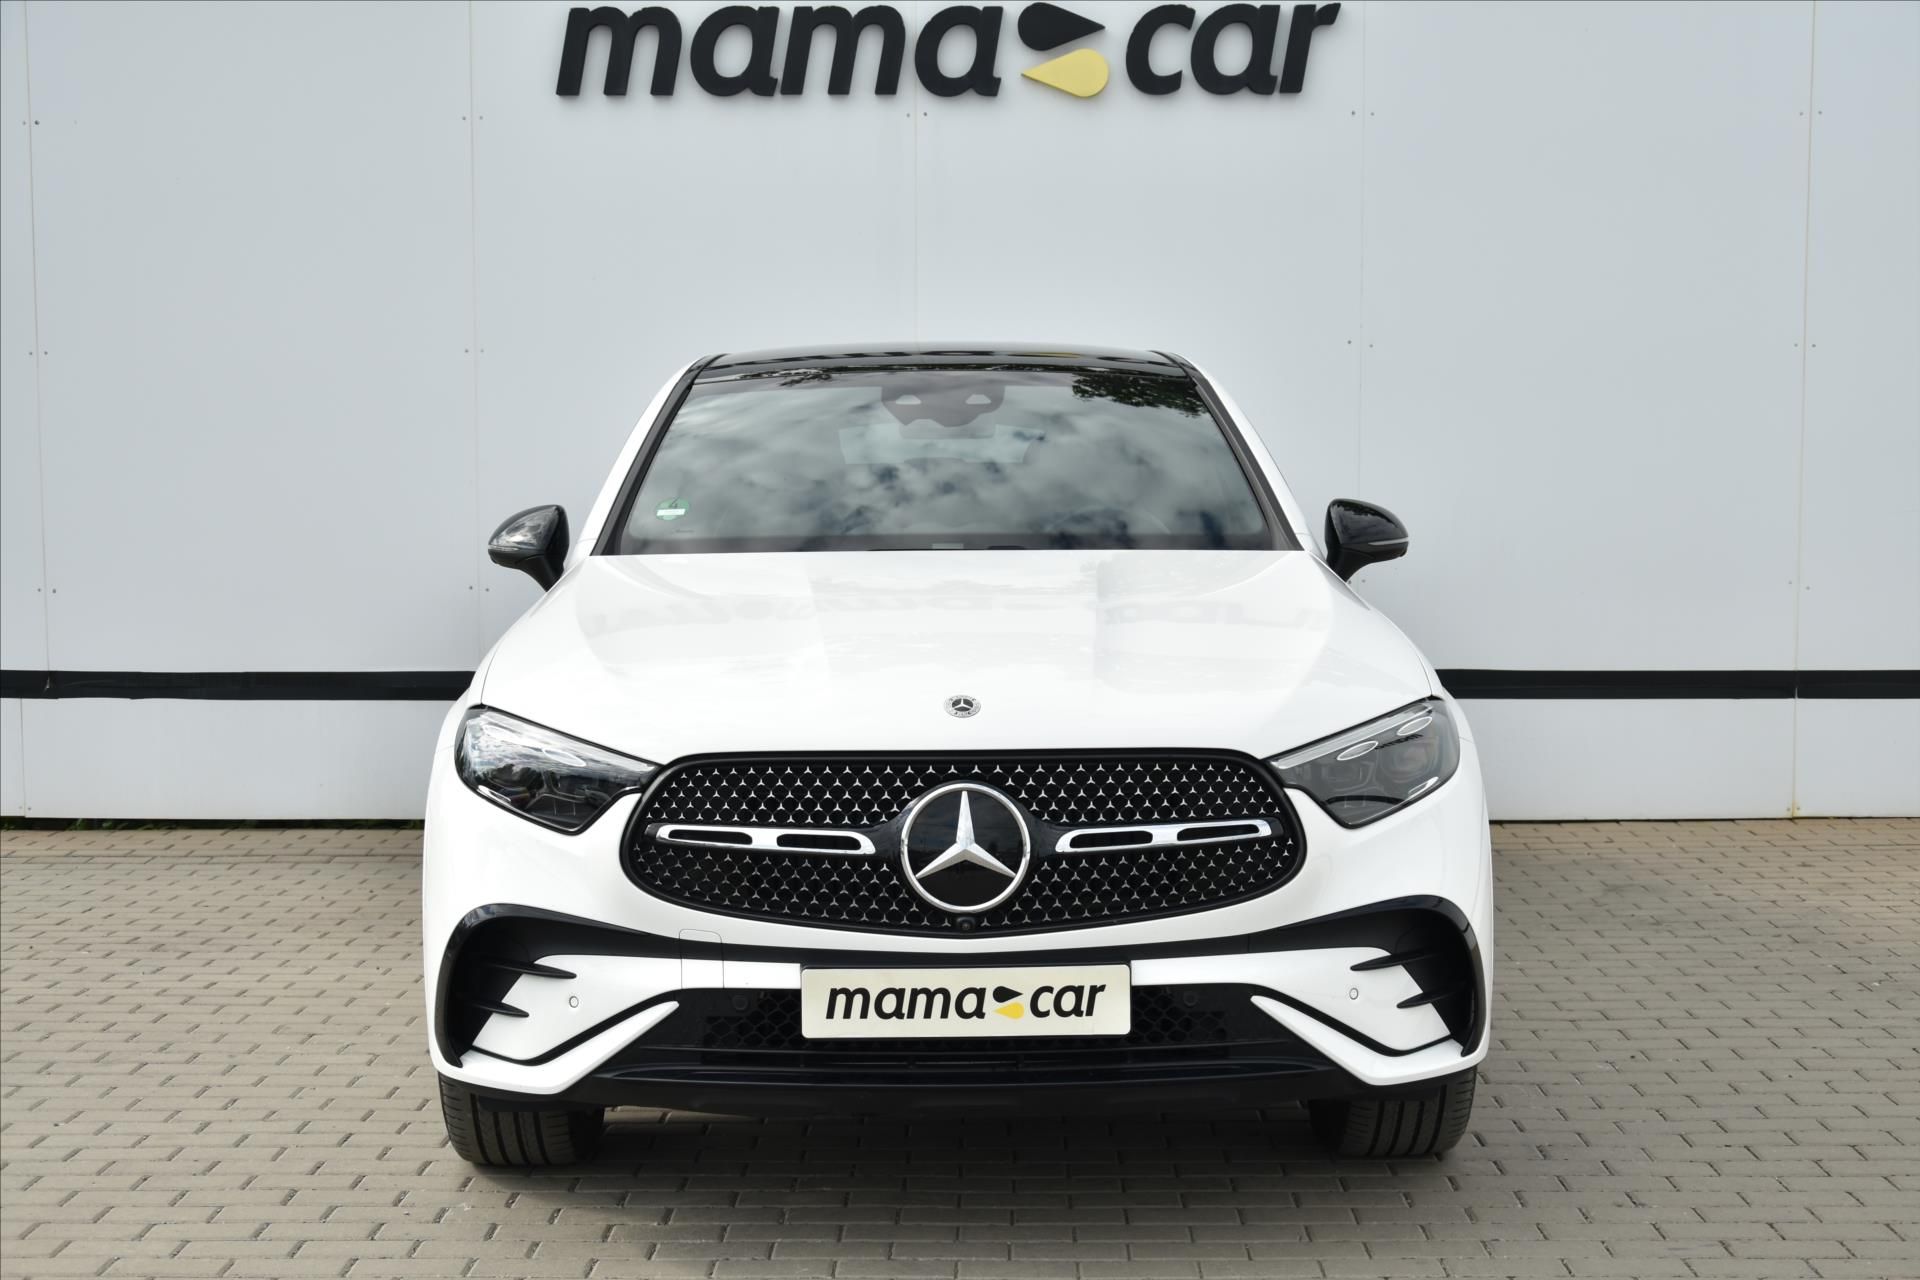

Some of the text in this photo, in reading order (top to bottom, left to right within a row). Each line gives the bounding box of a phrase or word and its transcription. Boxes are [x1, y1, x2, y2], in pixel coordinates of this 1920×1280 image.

[556, 3, 1341, 97] mama car
[826, 984, 1107, 1019] mama car
